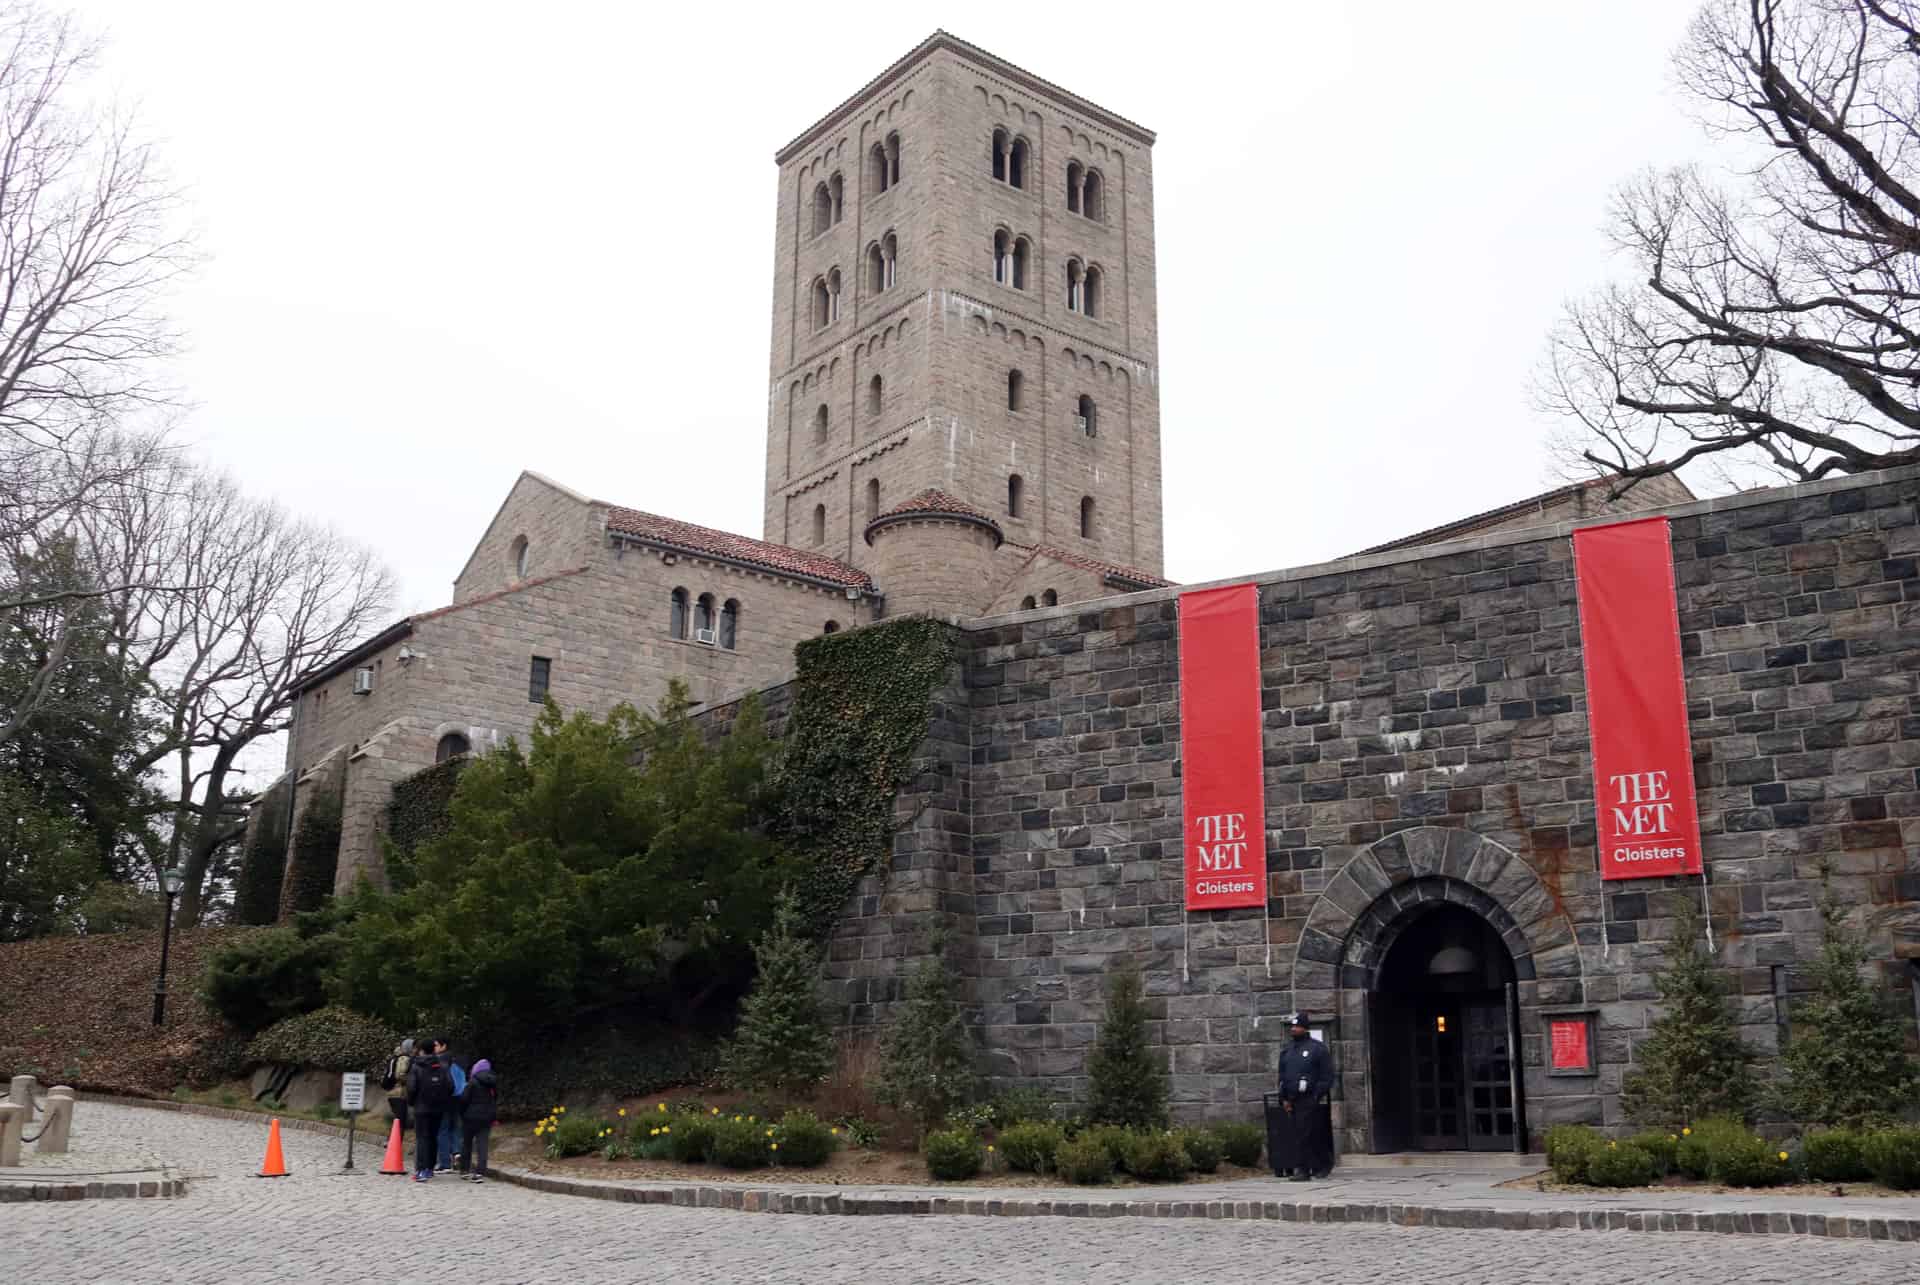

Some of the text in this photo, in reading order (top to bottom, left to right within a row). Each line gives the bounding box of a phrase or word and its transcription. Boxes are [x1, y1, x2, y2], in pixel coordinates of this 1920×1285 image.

[1610, 770, 1671, 804] THE
[1196, 813, 1246, 842] THE
[1610, 803, 1673, 837] MET
[1196, 842, 1248, 871] MET
[1614, 847, 1686, 862] Cloisters
[1196, 881, 1255, 895] Cloisters
